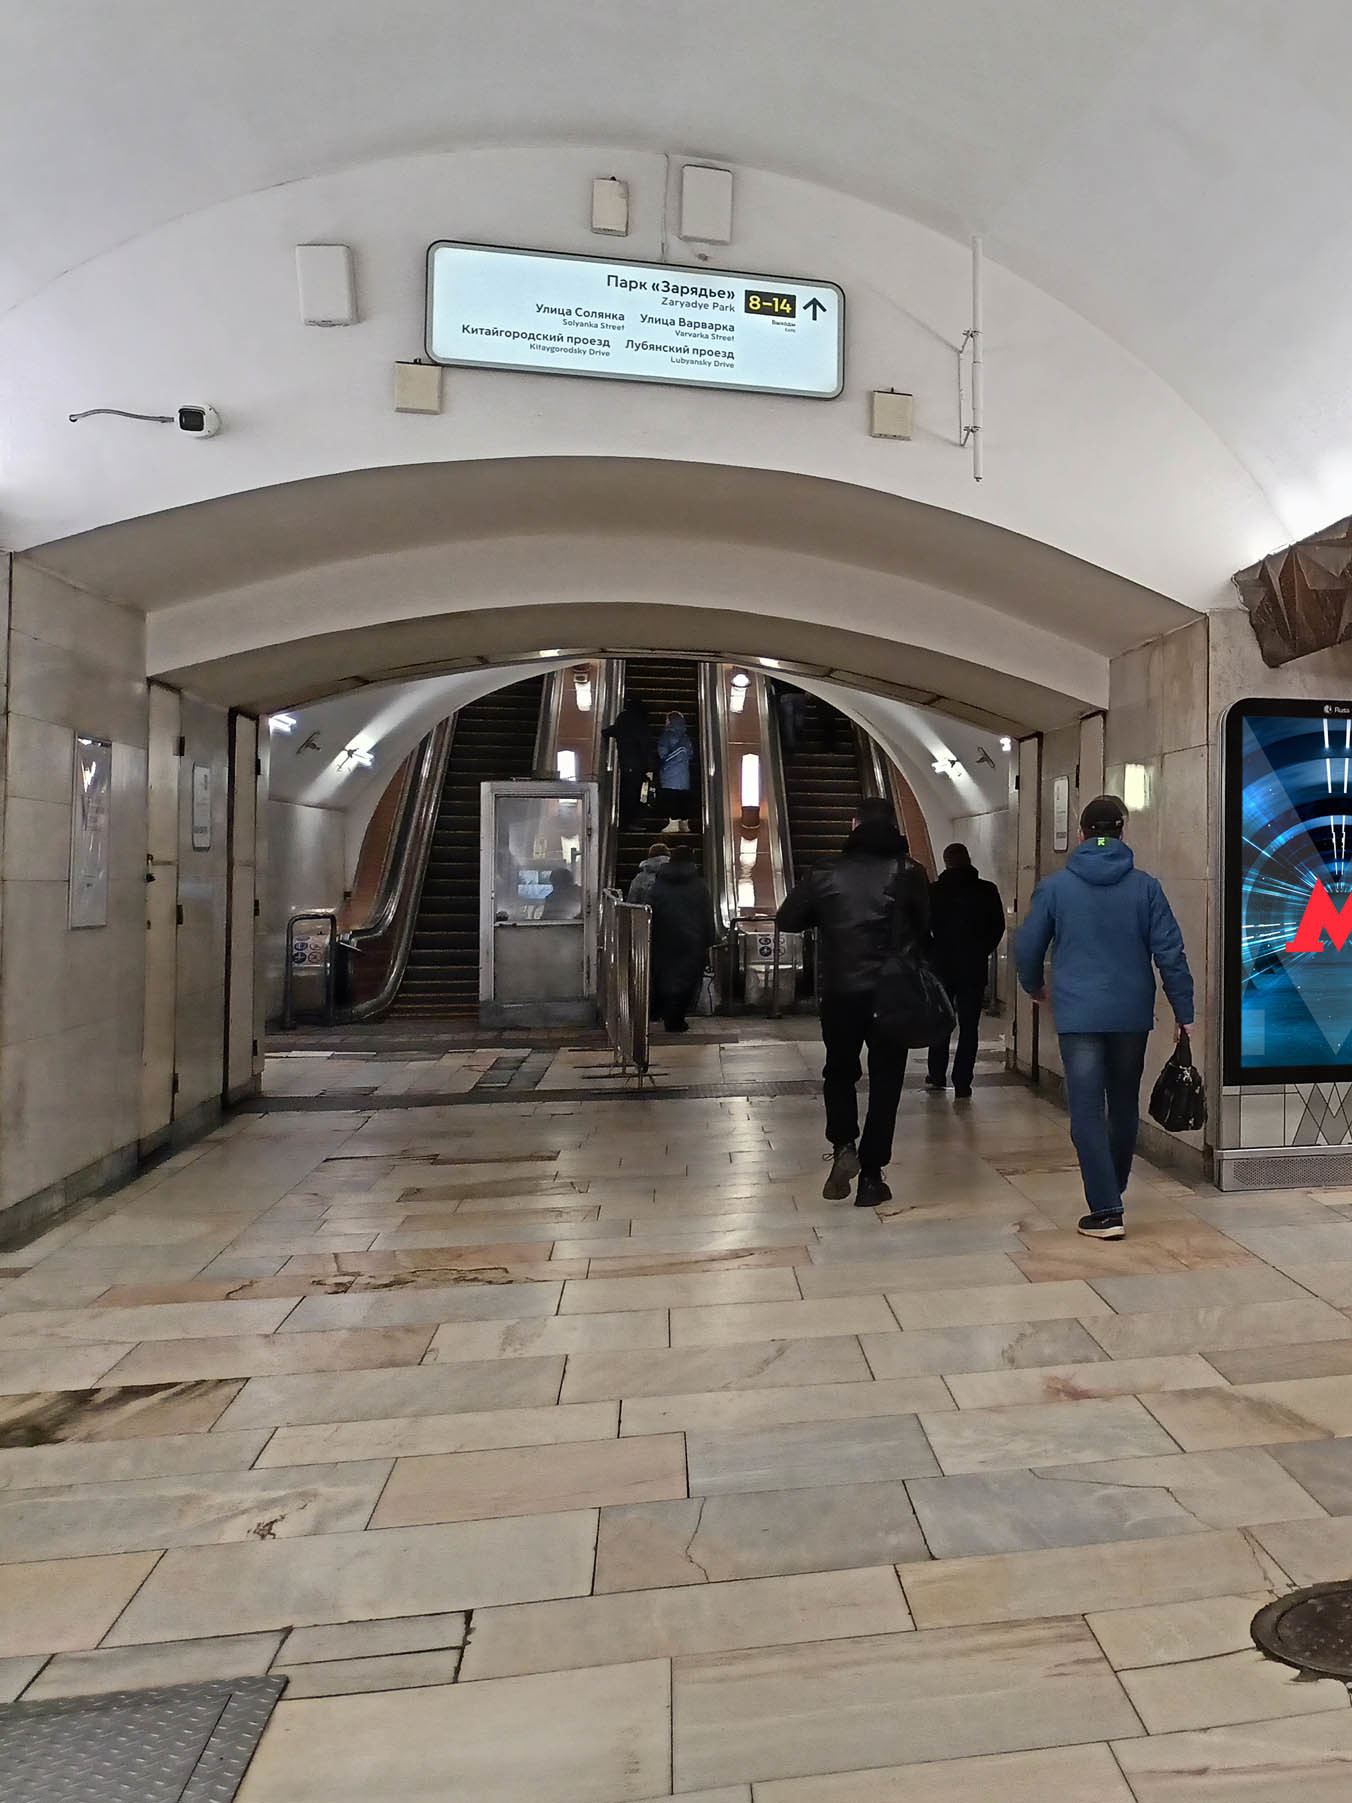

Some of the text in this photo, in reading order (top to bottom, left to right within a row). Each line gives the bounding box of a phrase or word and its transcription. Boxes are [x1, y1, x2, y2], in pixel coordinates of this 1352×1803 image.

[607, 274, 735, 299] Парк «Зарядье»
[536, 303, 625, 321] Улица Солянка
[661, 297, 735, 312] Zaryadye Park
[562, 319, 625, 331] Solyanka Street
[640, 313, 735, 332] Улица Варварка
[462, 324, 611, 348] Китайгородский проезд
[675, 330, 735, 342] Varvarka Street
[530, 343, 611, 357] Kitaygorodsky Drive
[625, 339, 735, 360] Лубянский проезд
[670, 356, 735, 369] Lubyansky Drive
